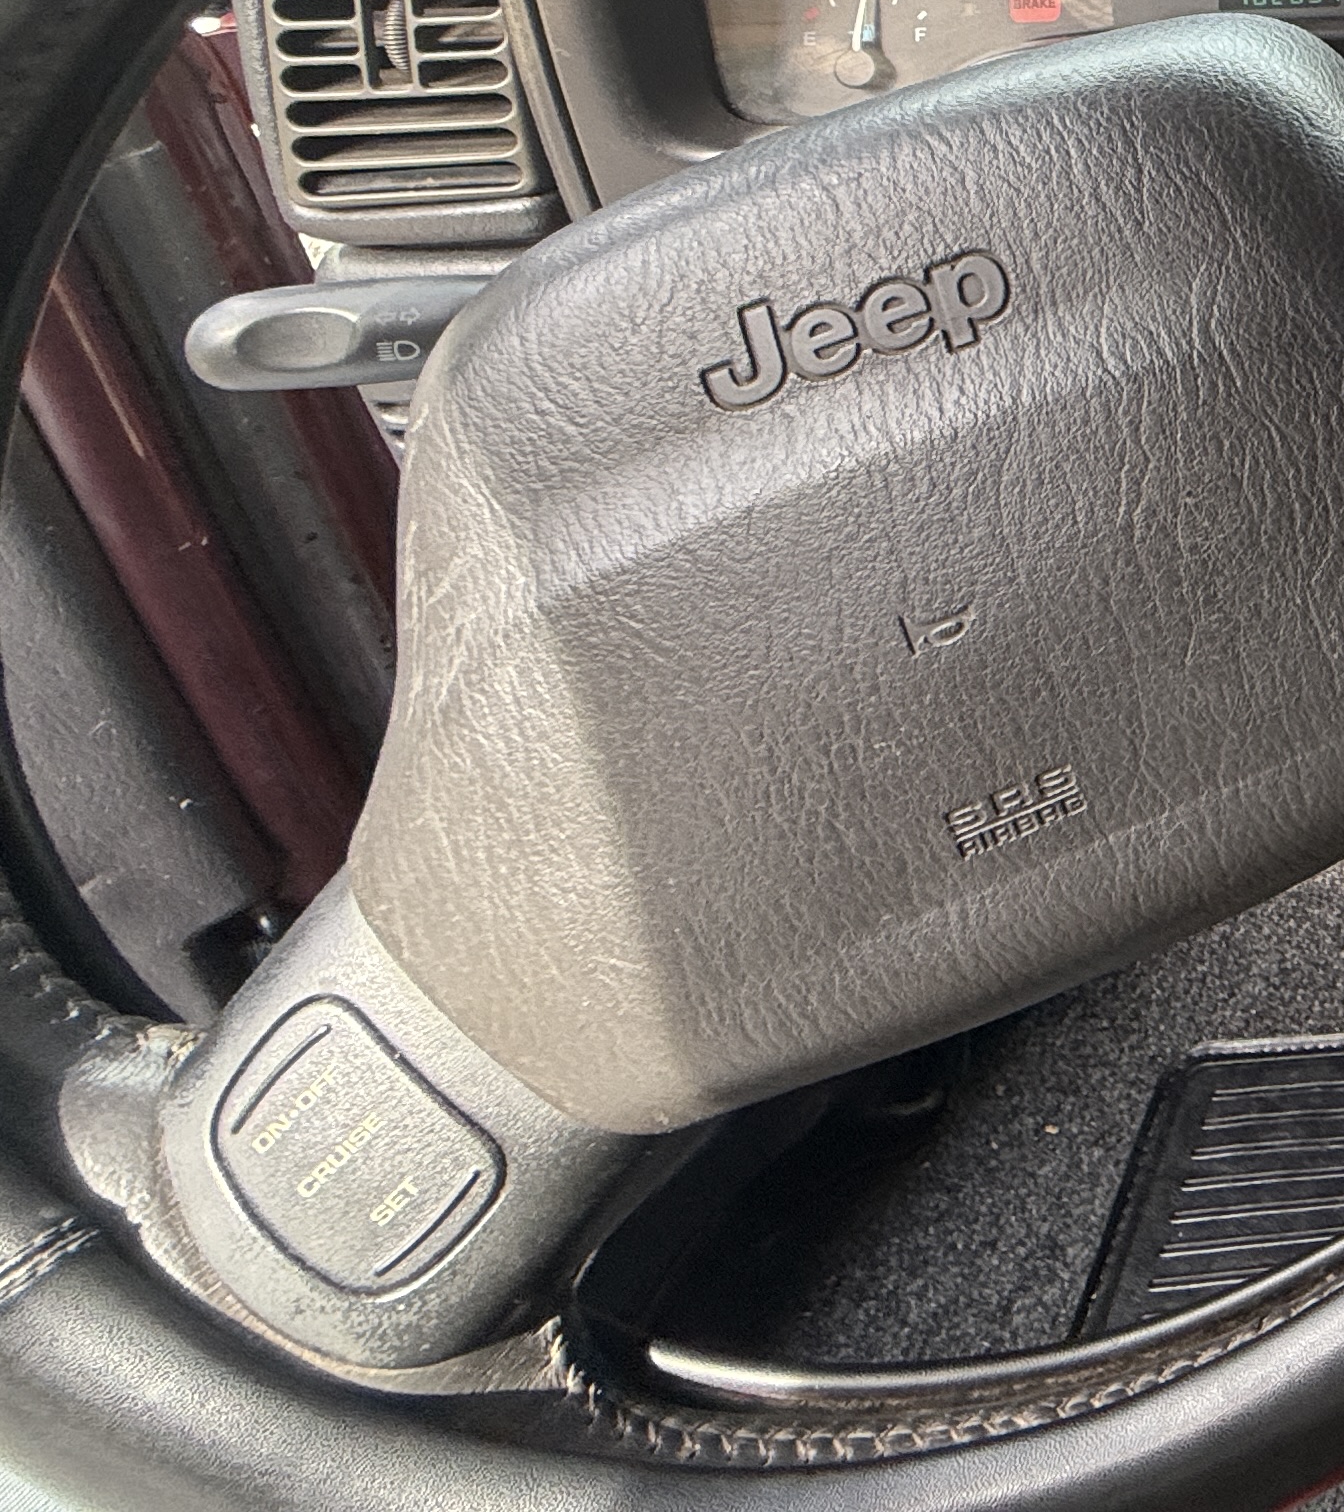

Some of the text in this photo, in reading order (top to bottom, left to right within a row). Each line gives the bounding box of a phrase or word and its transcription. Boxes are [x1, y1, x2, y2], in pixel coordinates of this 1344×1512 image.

[804, 31, 816, 46] E
[915, 27, 928, 42] F
[700, 249, 1011, 411] Jeep
[942, 764, 1077, 835] SRS
[957, 793, 1088, 862] AIRBAG
[297, 1112, 387, 1198] CRUISE
[370, 1175, 419, 1227] SET
